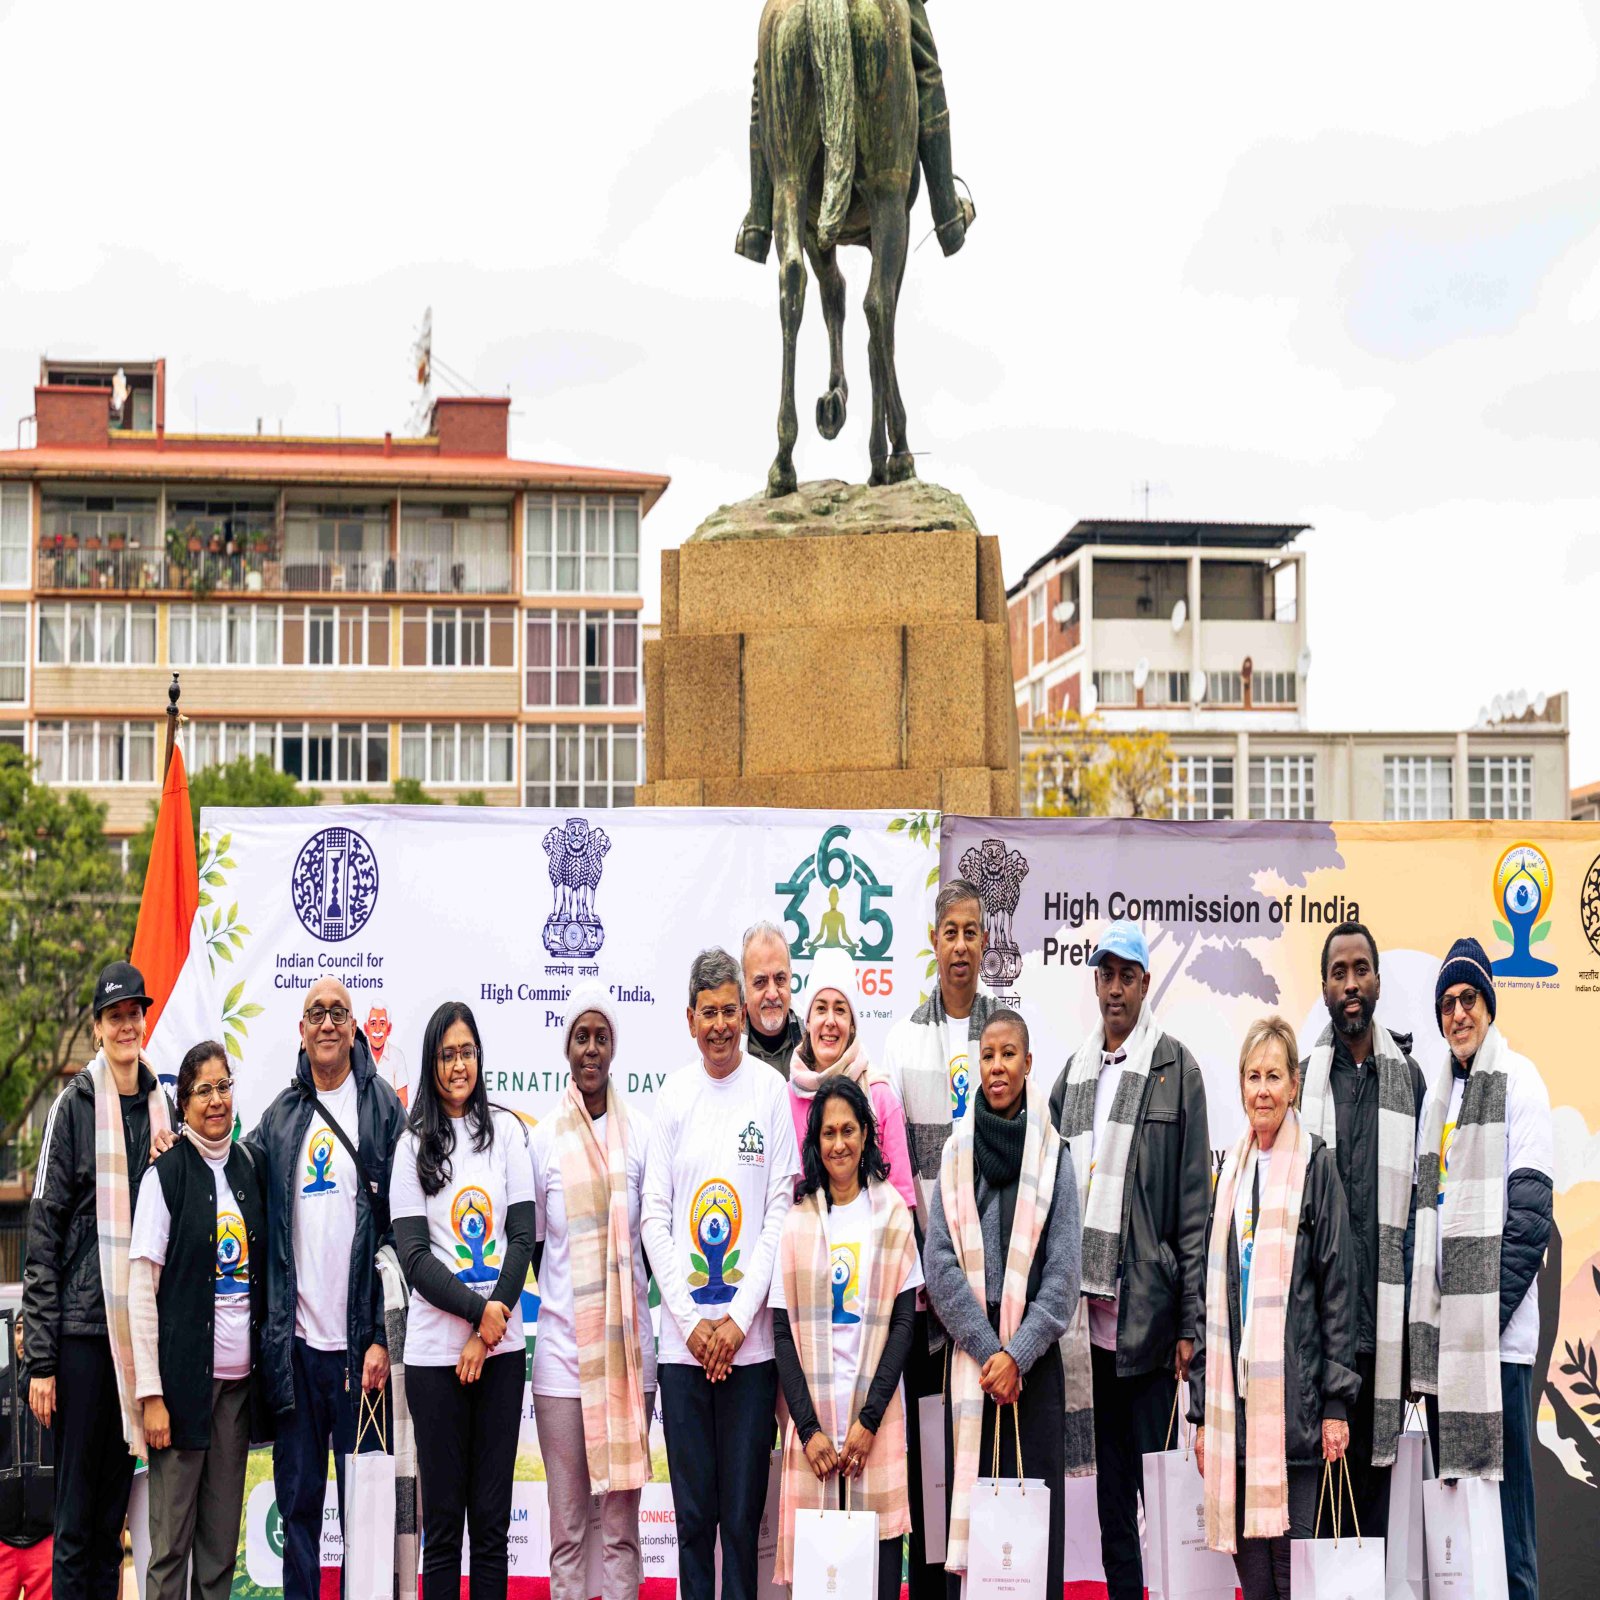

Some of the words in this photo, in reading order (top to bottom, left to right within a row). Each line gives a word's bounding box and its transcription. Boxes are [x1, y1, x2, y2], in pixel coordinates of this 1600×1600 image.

[1044, 892, 1099, 928] High
[1107, 891, 1260, 923] Commission
[1268, 895, 1293, 923] of
[1300, 895, 1360, 923] India
[1043, 937, 1099, 966] Pret
[276, 953, 314, 968] Indian
[318, 953, 363, 968] Council
[367, 952, 384, 968] for
[544, 963, 574, 976] सत्यमेव
[578, 962, 600, 977] जयते
[856, 968, 893, 996] 65
[1507, 981, 1534, 990] Harmony
[480, 983, 513, 1004] High
[617, 985, 656, 1005] India,
[866, 1010, 871, 1018] a
[873, 1009, 893, 1018] Year!
[738, 1153, 755, 1163] Yoga
[755, 1154, 765, 1164] 365
[717, 1184, 728, 1194] day
[638, 1510, 676, 1523] ONNEC
[508, 1534, 529, 1543] tress
